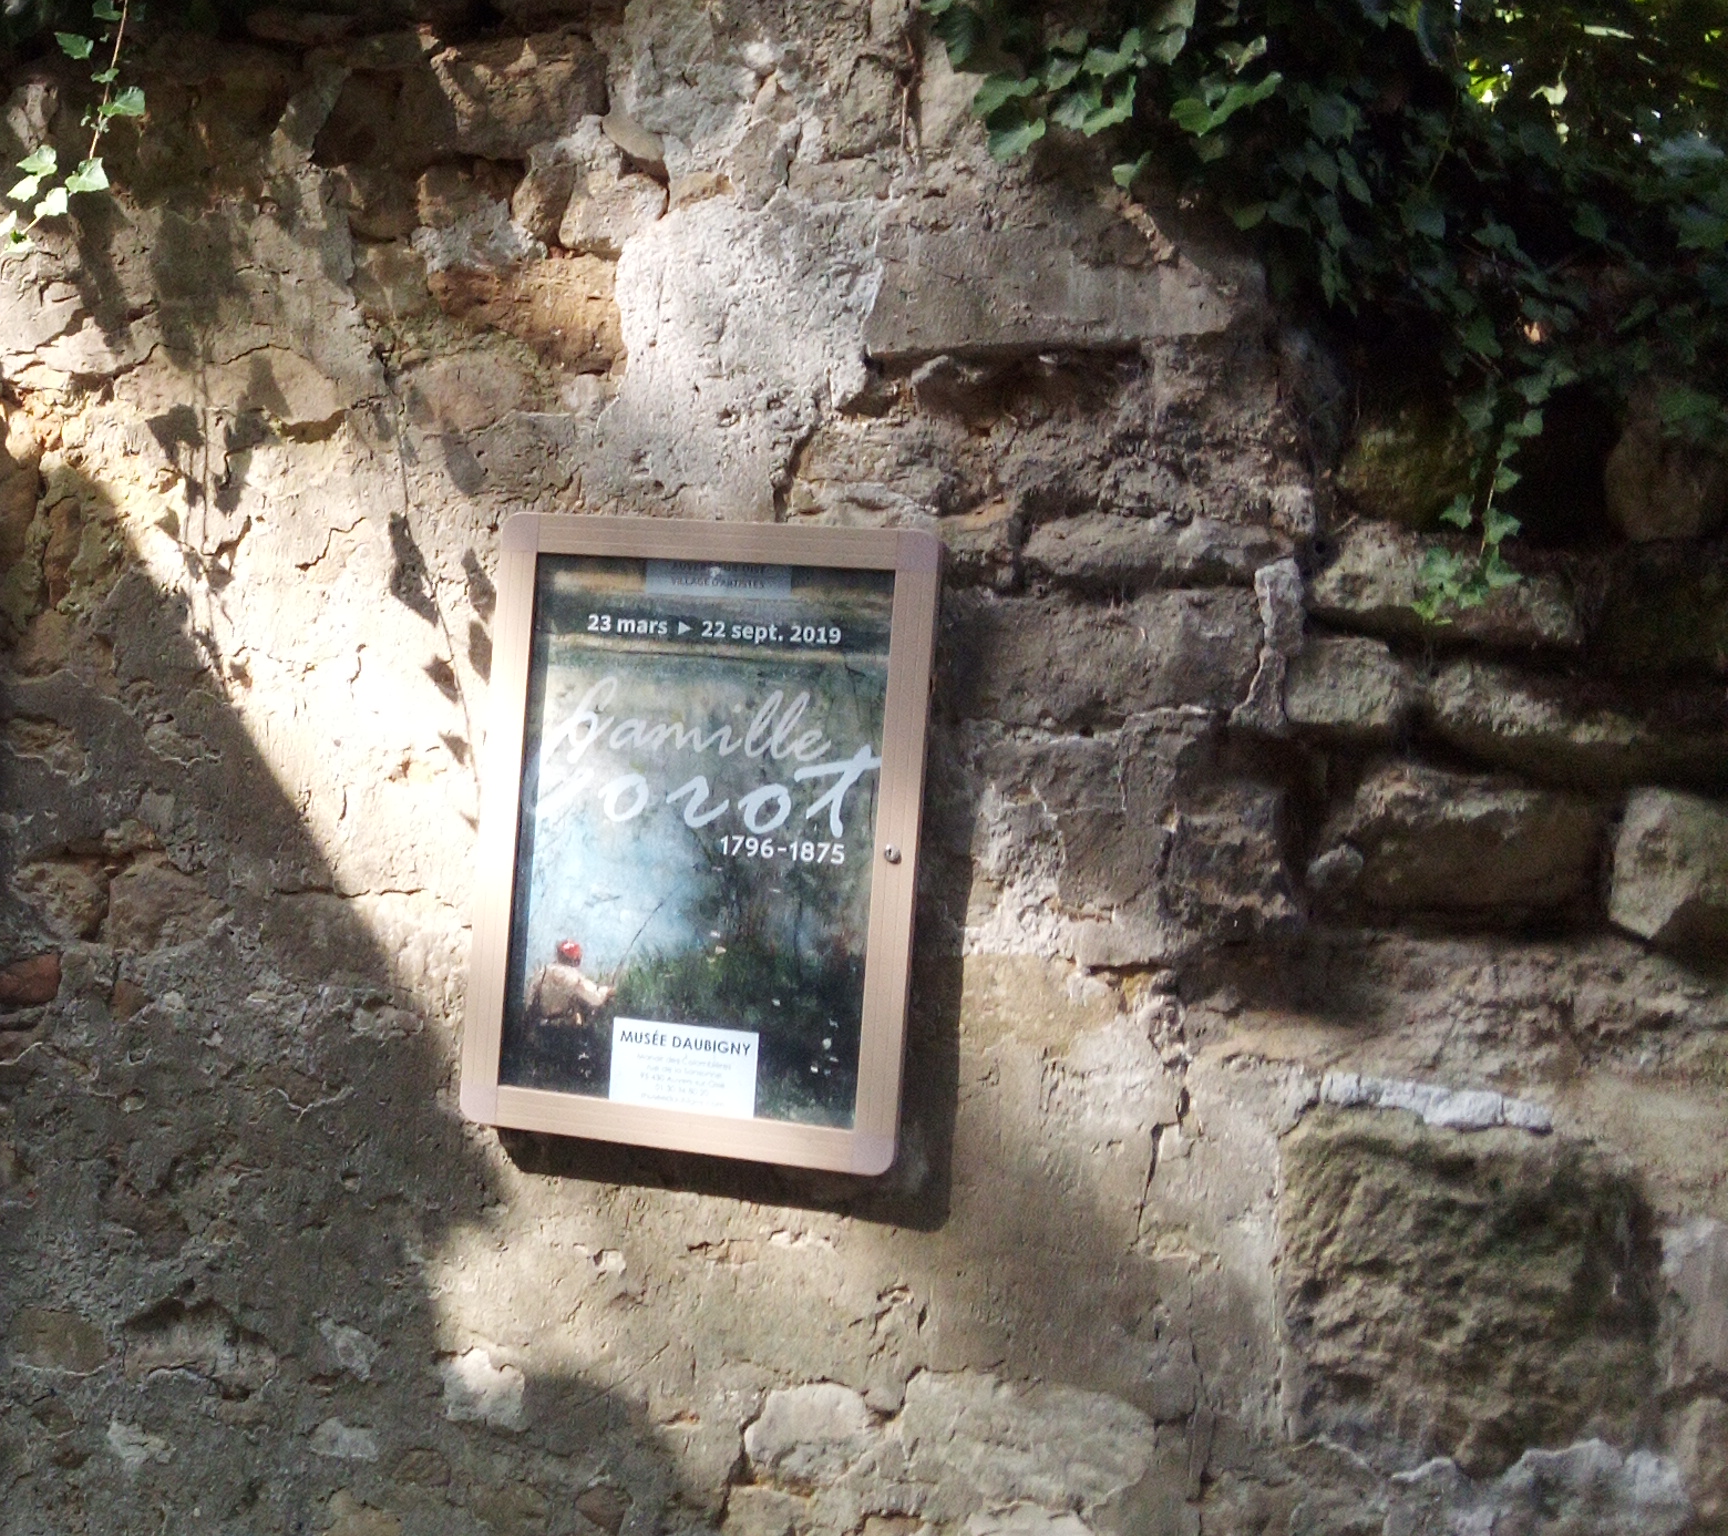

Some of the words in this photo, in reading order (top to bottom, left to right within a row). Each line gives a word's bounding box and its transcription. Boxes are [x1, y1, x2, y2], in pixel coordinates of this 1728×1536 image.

[587, 614, 612, 632] 23
[617, 617, 668, 635] mars
[701, 620, 726, 638] 22
[731, 623, 784, 644] sept.
[789, 625, 842, 645] 2019
[720, 835, 845, 864] 1796-1875
[620, 1029, 667, 1047] MUSÉE
[672, 1035, 751, 1055] DAUBIGNY
